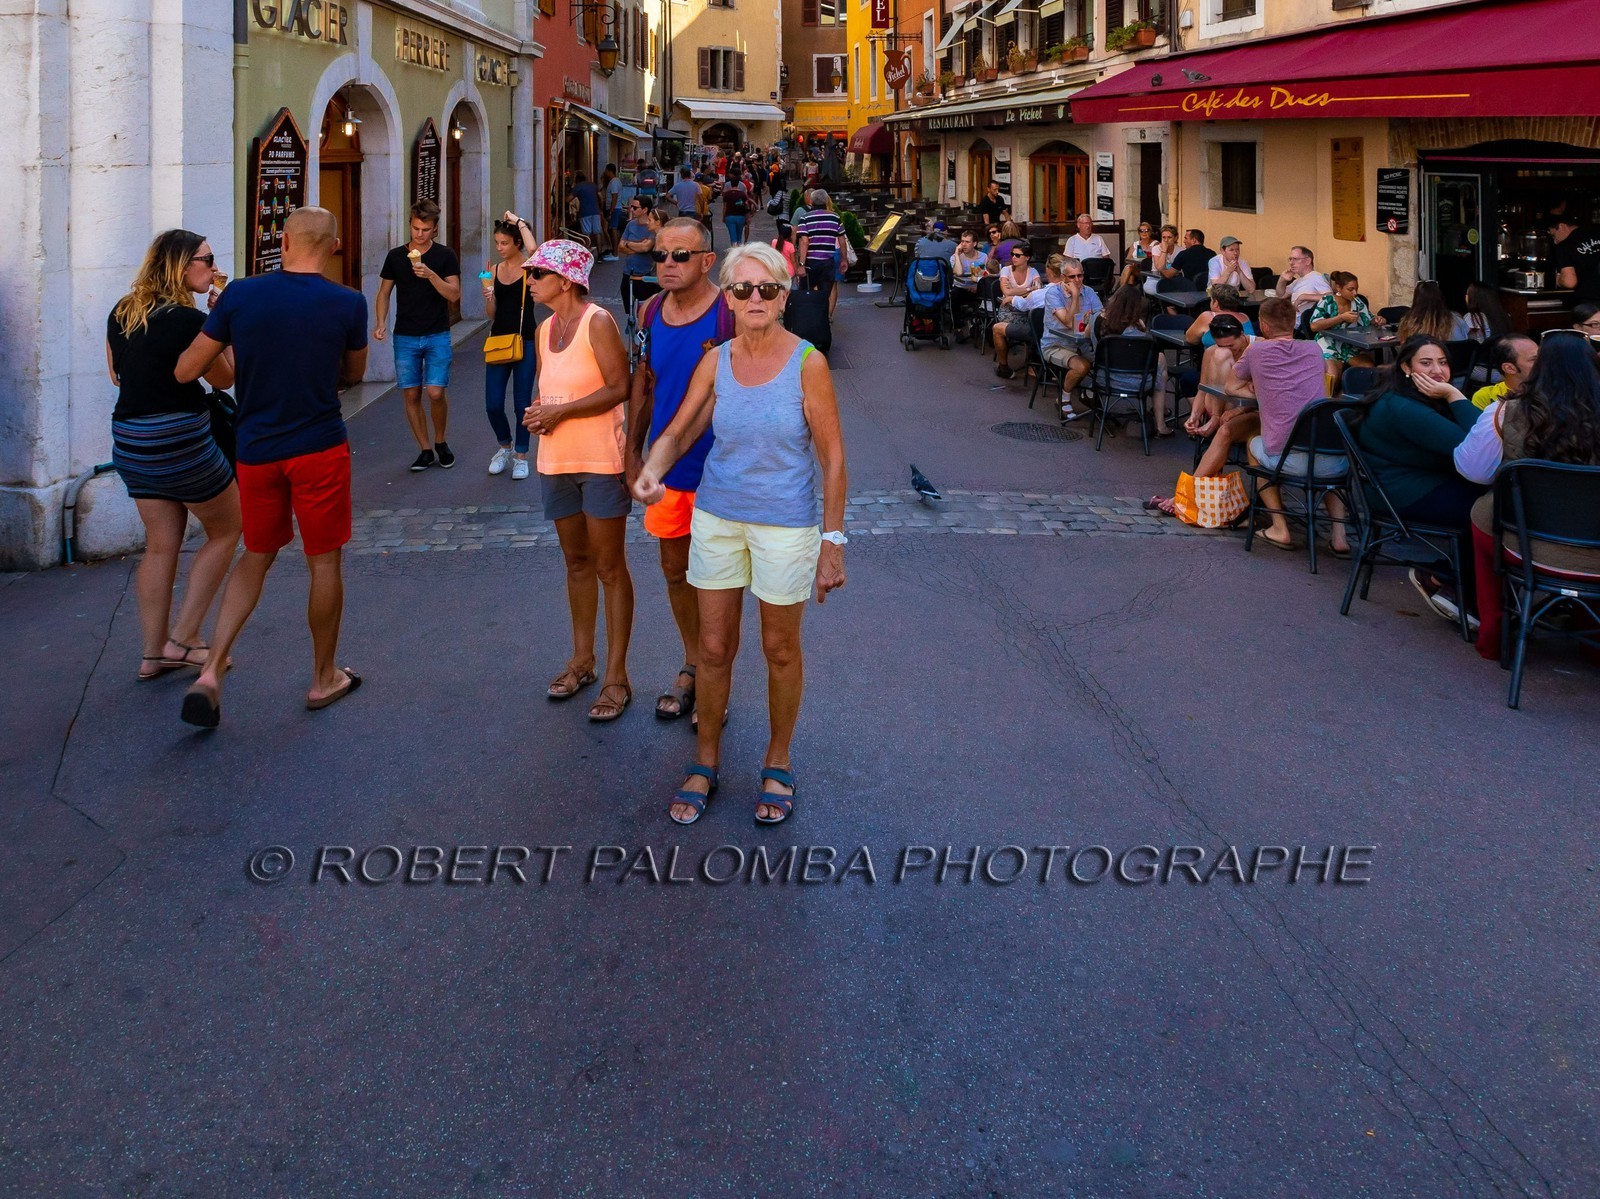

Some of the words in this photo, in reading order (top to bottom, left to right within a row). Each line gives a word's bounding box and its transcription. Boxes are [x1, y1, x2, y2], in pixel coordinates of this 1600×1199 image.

[1182, 90, 1225, 117] Café
[1224, 88, 1264, 109] des
[1270, 86, 1332, 110] Ducs
[928, 113, 975, 130] RESTAURANT
[1005, 108, 1016, 123] Le
[1019, 106, 1043, 122] Pichet
